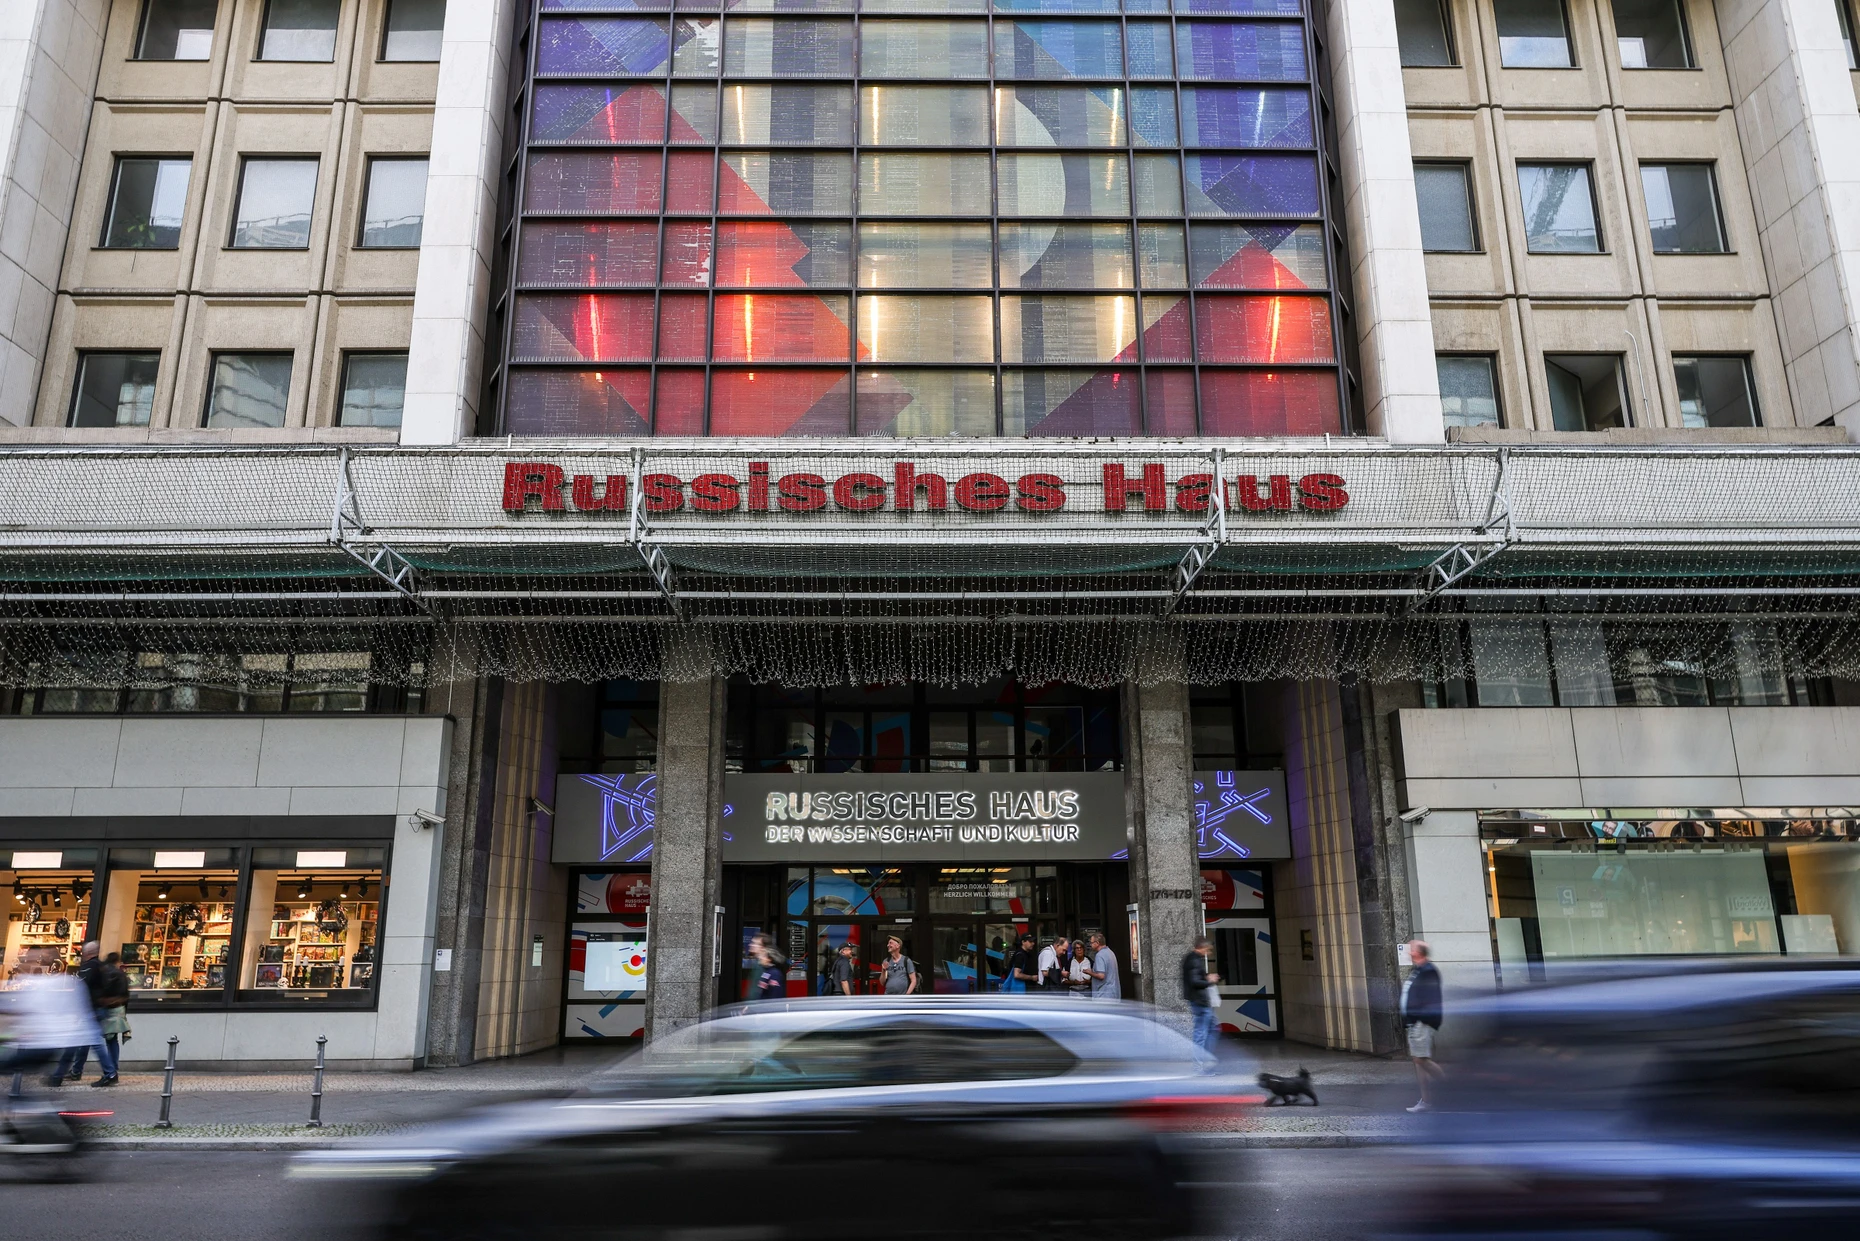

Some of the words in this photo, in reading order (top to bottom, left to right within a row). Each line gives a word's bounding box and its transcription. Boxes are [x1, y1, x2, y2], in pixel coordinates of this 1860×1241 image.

[502, 462, 1066, 514] Russisches
[1103, 462, 1351, 514] Haus
[766, 791, 976, 820] RUSSISCHES
[991, 790, 1080, 819] HAUS
[766, 825, 804, 843] DER
[807, 824, 954, 843] WISSENSCHAFT
[960, 824, 1001, 842] UND
[1004, 823, 1080, 842] KULTUR
[947, 883, 968, 891] ДОБРО
[1151, 889, 1192, 899] 176-179
